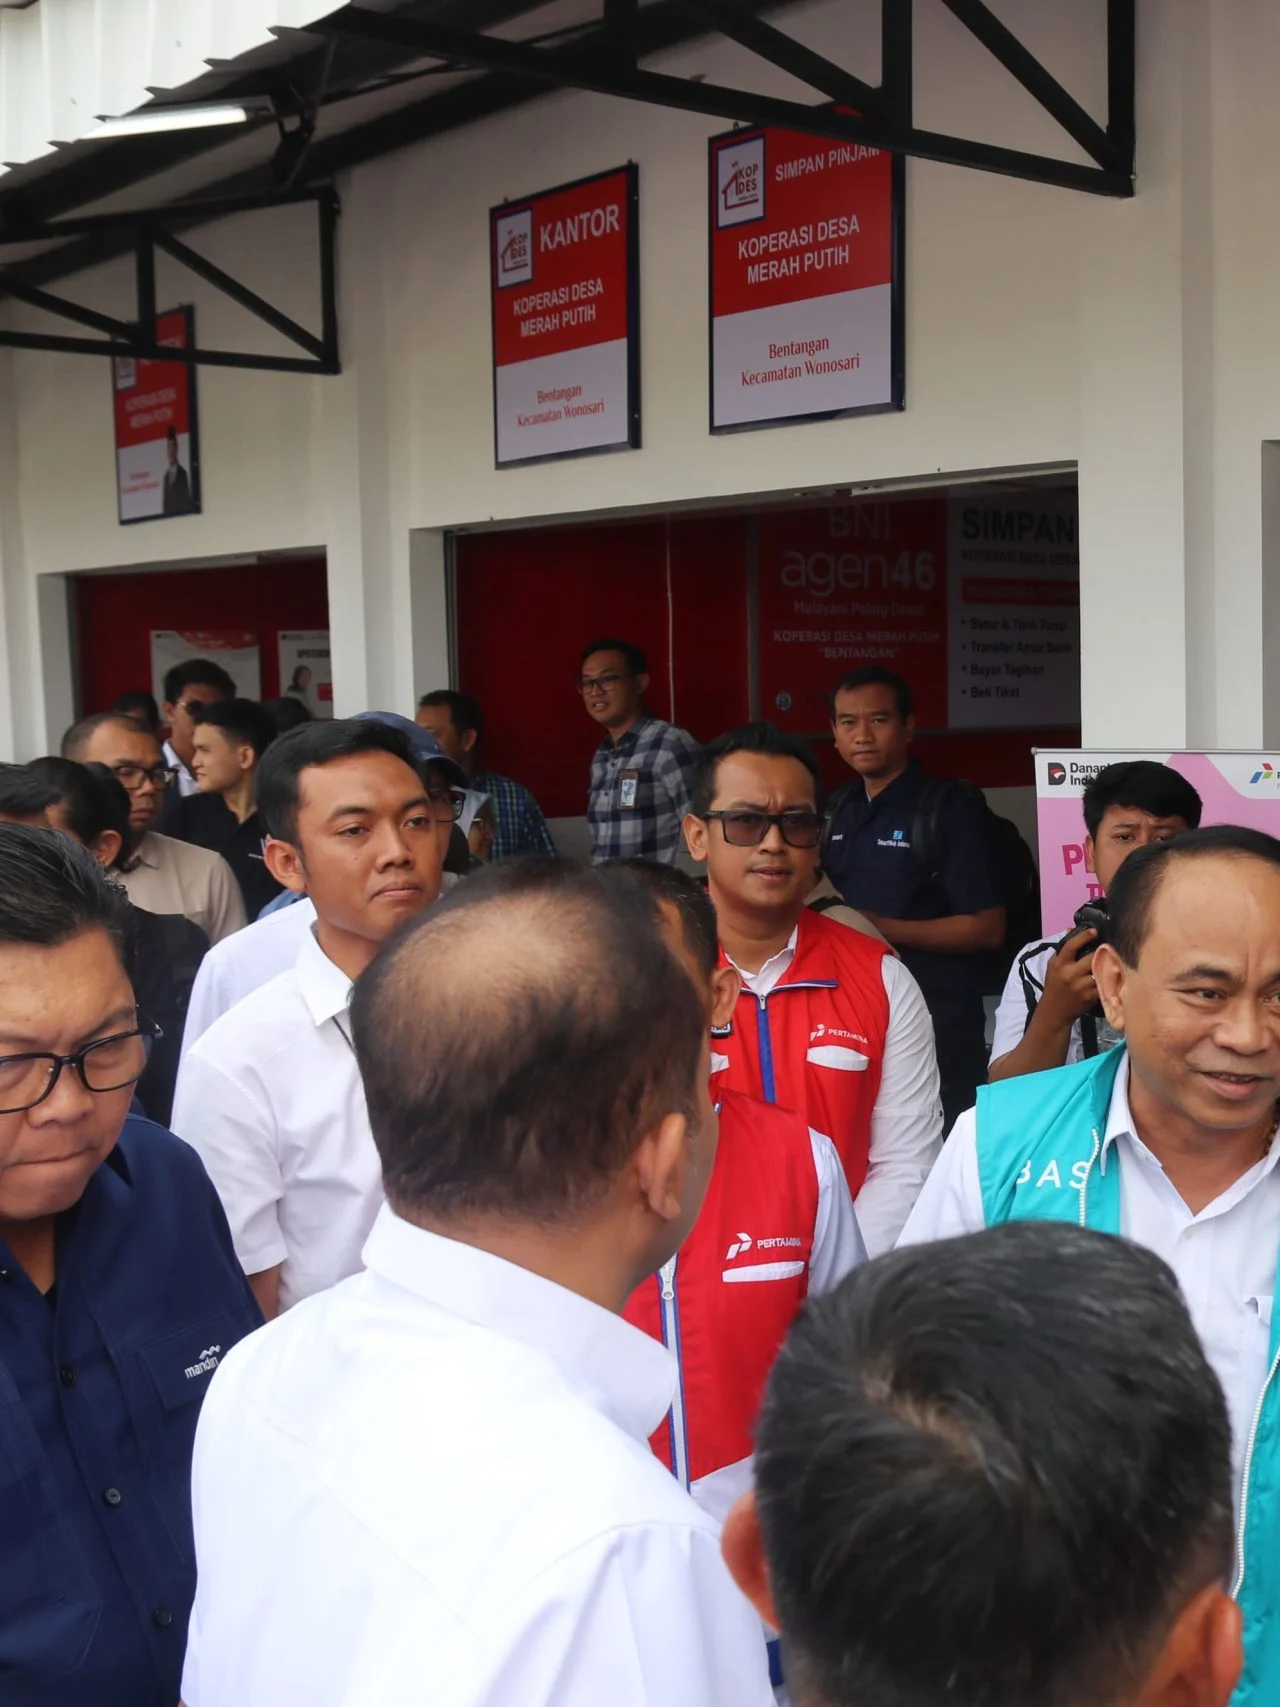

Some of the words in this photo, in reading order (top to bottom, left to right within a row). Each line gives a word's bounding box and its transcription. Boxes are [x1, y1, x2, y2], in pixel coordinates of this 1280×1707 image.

[738, 164, 759, 180] KOP
[775, 153, 824, 181] SIMPAN
[738, 178, 757, 194] DES
[540, 204, 620, 253] KANTOR
[738, 223, 812, 260] KOPERASI
[818, 214, 860, 241] DESA
[748, 255, 800, 284] MERAH
[804, 245, 849, 272] PUTIH
[513, 286, 569, 316] KOPERASI
[571, 277, 604, 301] DESA
[520, 313, 560, 338] MERAH
[562, 304, 596, 328] PUTIH
[769, 337, 829, 359] Bentangan
[741, 365, 801, 387] Kecamatan
[804, 352, 860, 377] Wonosari
[537, 385, 581, 404] Bentangan
[517, 409, 562, 427] Kecamatan
[563, 398, 604, 419] Wonosari
[828, 502, 891, 541] BNI
[962, 508, 1075, 544] SIMPAN
[780, 550, 936, 598] agen46
[773, 629, 831, 643] KOPERASI
[834, 630, 863, 643] DESA
[866, 630, 906, 643] MERAH
[970, 663, 1001, 678] Bayar
[1004, 664, 1044, 677] Tagihan
[970, 687, 991, 698] Beli
[828, 1028, 869, 1045] PERTAMINA
